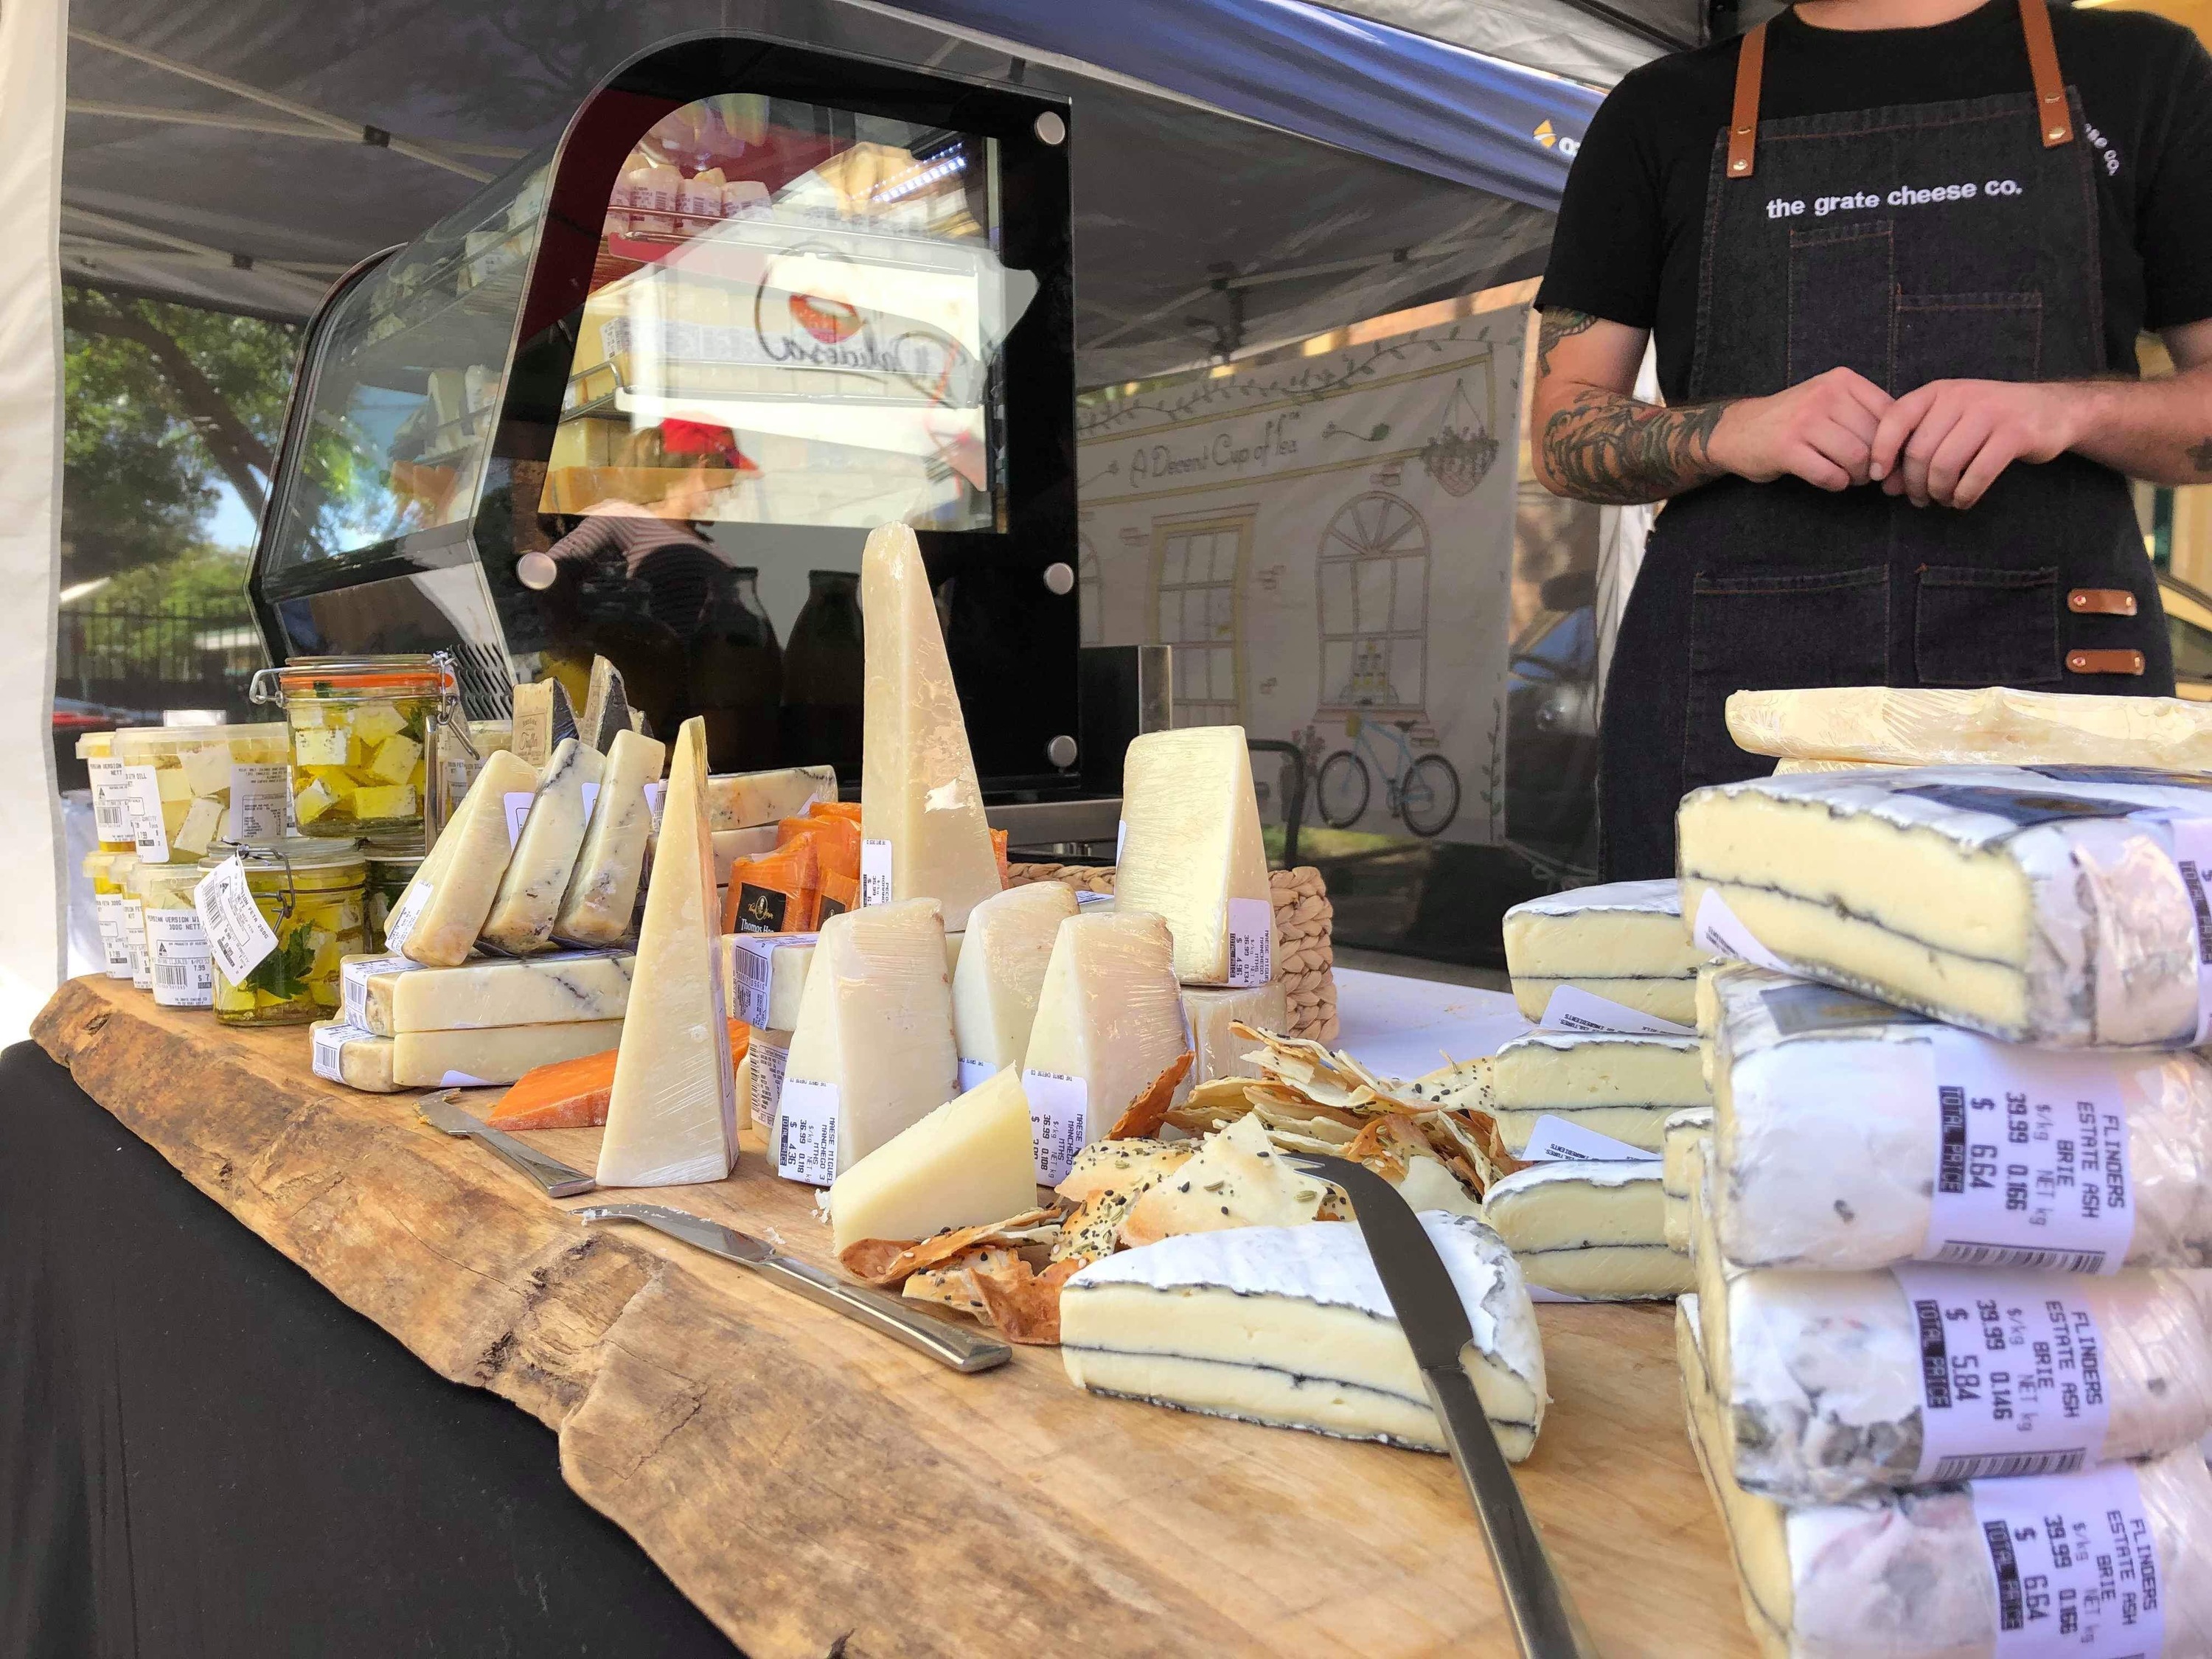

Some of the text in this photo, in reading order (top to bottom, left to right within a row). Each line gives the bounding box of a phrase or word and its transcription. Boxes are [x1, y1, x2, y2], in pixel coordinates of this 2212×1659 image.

[1766, 178, 2023, 218] the grate cheese co.
[1129, 448, 1147, 488] A
[1152, 445, 1209, 478] Decent
[1211, 433, 1250, 472] Cup
[1254, 420, 1275, 466] of
[248, 906, 258, 923] FETA
[257, 924, 269, 940] 250G
[741, 918, 762, 933] Thomas
[1564, 1014, 1604, 1031] INGREDIENTS
[780, 1143, 788, 1166] PRICE
[787, 1143, 796, 1165] 4.36
[1040, 1114, 1051, 1171] 36.99 0.108
[1051, 1121, 1059, 1138] $/kg
[1066, 1121, 1074, 1166] MANCHEGO
[1550, 1143, 1589, 1160] INGREDIENTS
[1939, 1087, 1966, 1192] TOTAL PRICE
[1969, 1097, 1997, 1189] $ 6.64
[2005, 1092, 2028, 1211] 39.99 0.166
[797, 1152, 805, 1174] 0.118
[804, 1174, 813, 1183] kg
[827, 1150, 835, 1183] MIGUEL
[1048, 1169, 1057, 1178] kg
[2028, 1104, 2055, 1225] $/kg NET kg
[2056, 1139, 2075, 1187] BRIE
[2077, 1101, 2100, 1219] ESTATE ASH
[2102, 1114, 2125, 1209] FLINDERS
[1945, 1308, 1981, 1401] $ 5.84
[1976, 1299, 2013, 1421] 39.99 0.146
[2006, 1307, 2039, 1432] $/kg NET kg
[2033, 1341, 2055, 1389] BRIE
[2045, 1301, 2080, 1418] ESTATE ASH
[2070, 1311, 2103, 1405] FLINDERS
[2044, 1514, 2073, 1568] 39.99
[2073, 1522, 2090, 1562] $/kg
[2084, 1588, 2101, 1615] NET
[2107, 1510, 2138, 1625] ESTATE ASH
[2130, 1518, 2157, 1611] FLINDERS
[2014, 1527, 2050, 1622] $ 6.64
[2096, 1554, 2116, 1601] BRIE
